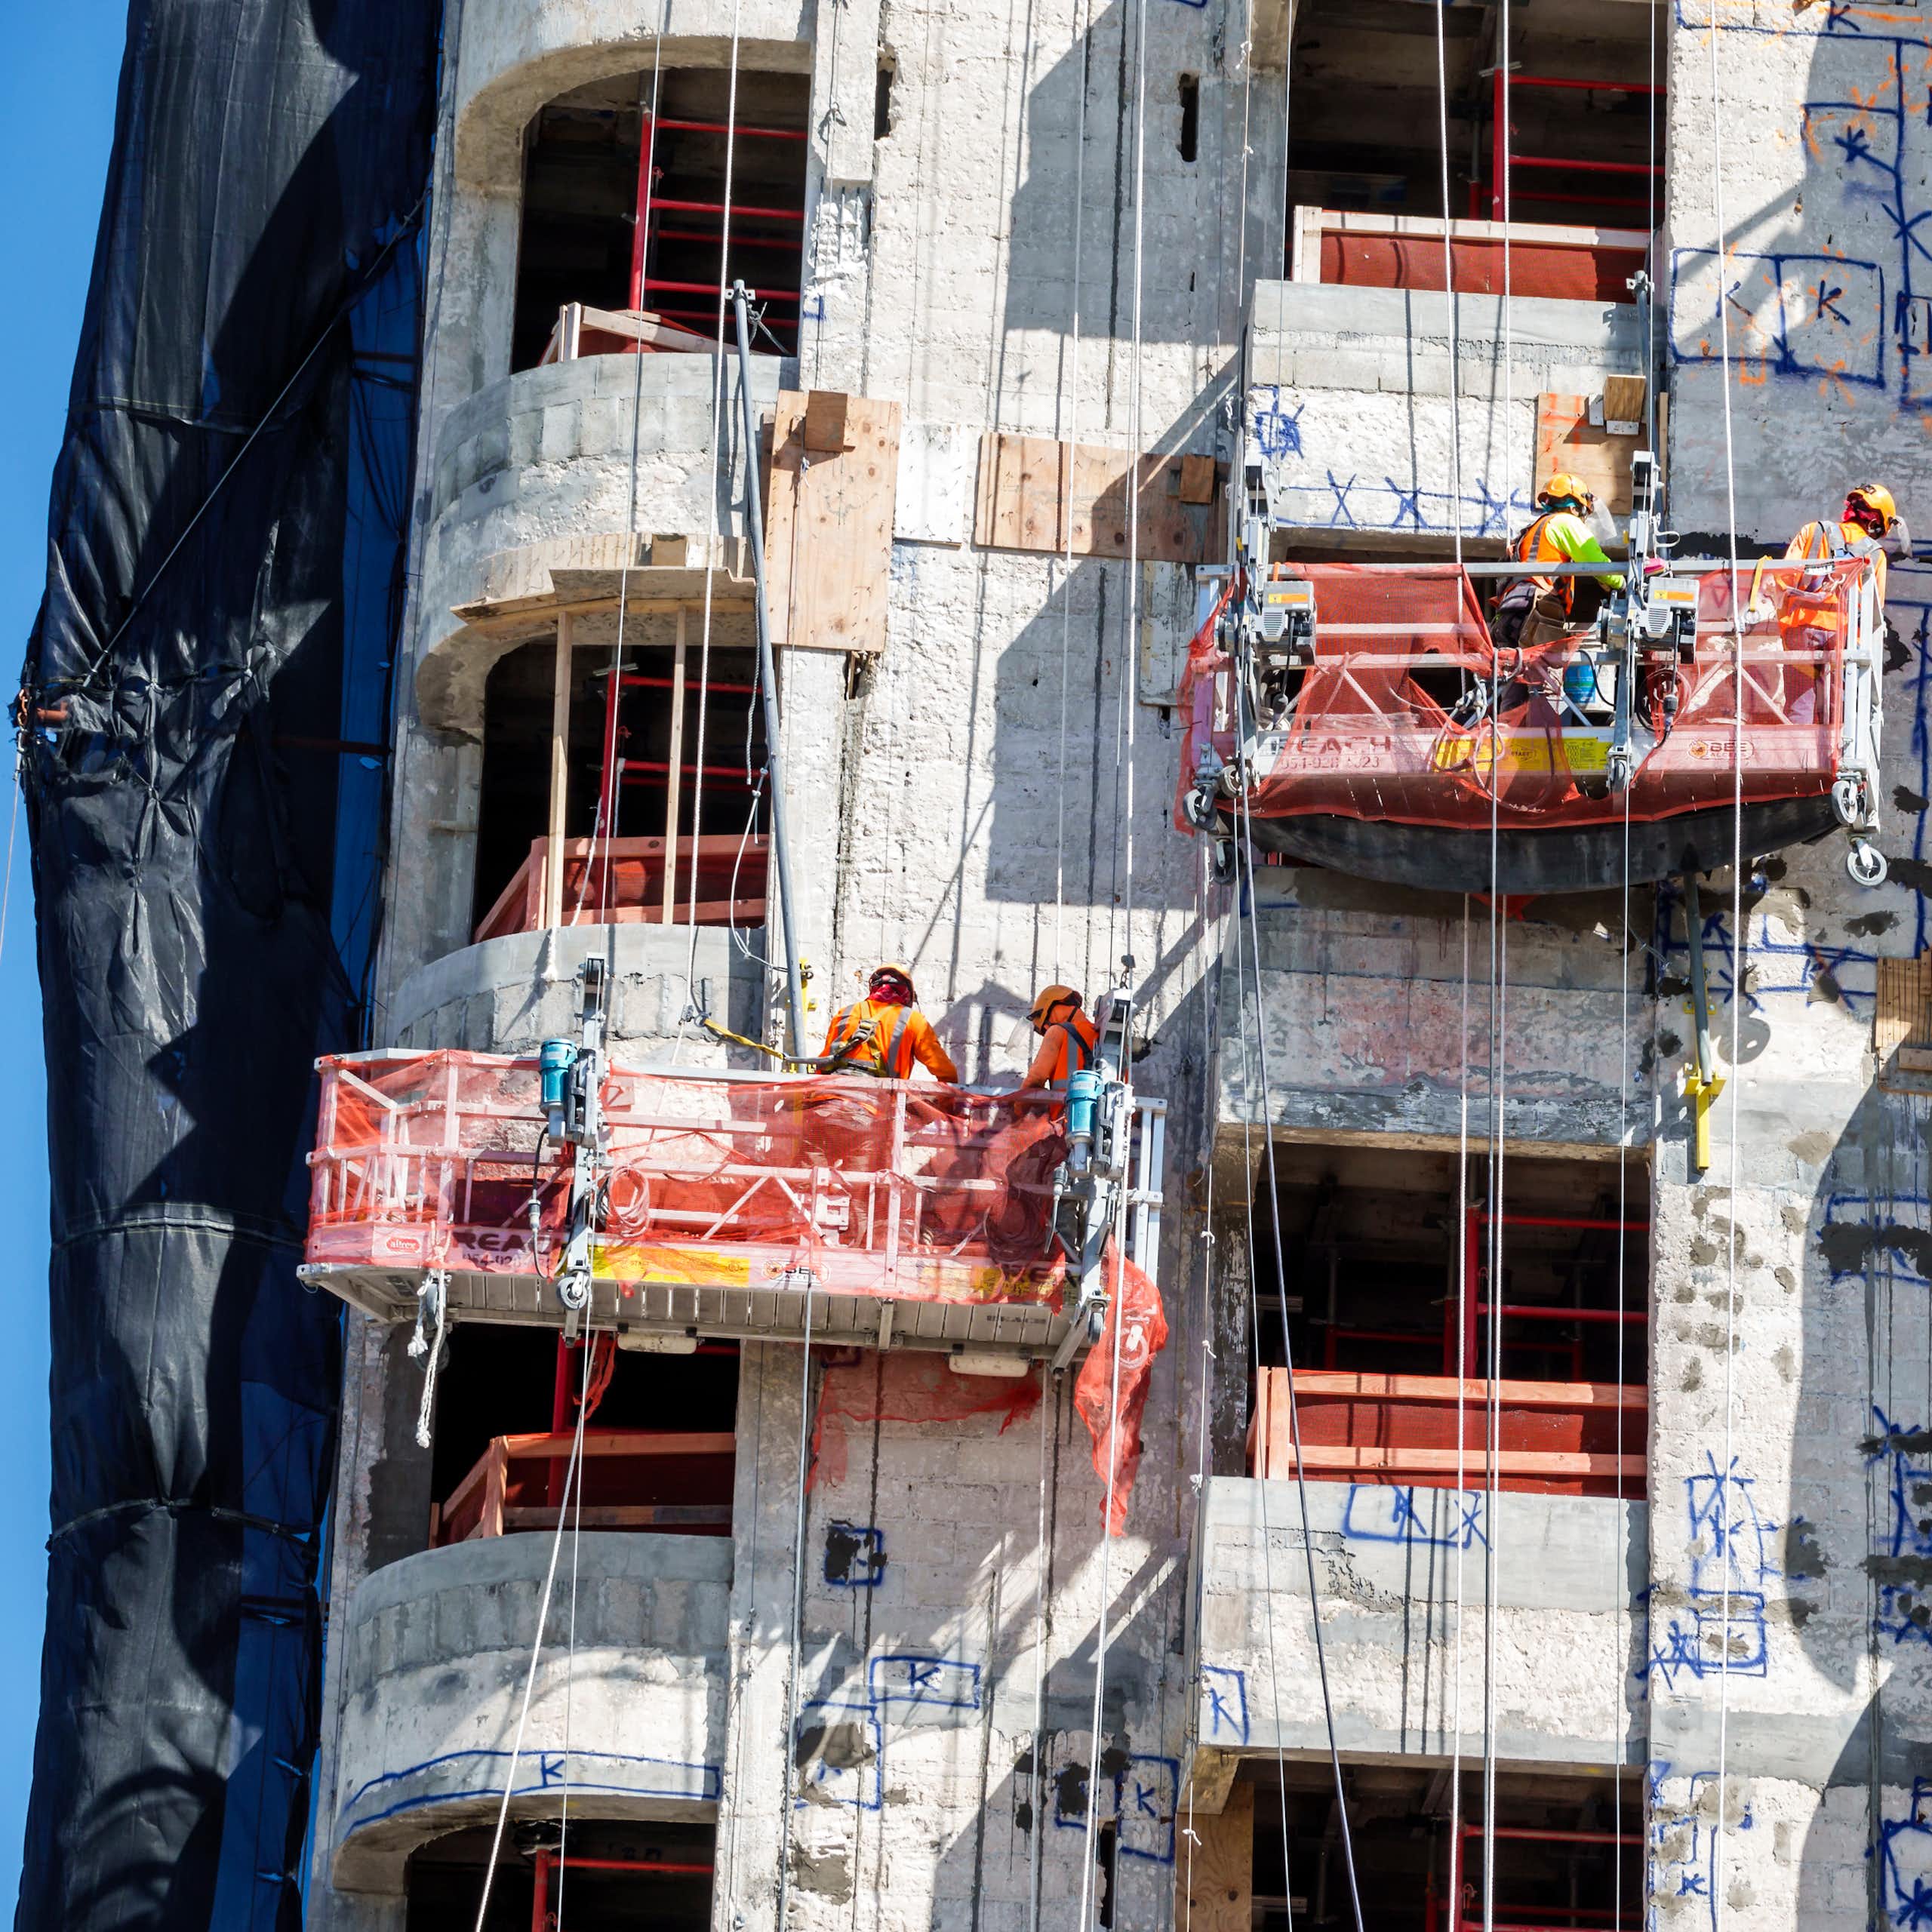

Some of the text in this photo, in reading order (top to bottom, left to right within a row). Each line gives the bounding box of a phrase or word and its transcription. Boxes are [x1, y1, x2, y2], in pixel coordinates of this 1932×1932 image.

[1817, 280, 1851, 325] K
[909, 1662, 941, 1694] K
[1210, 1687, 1244, 1739] K
[541, 1755, 565, 1788] K
[1137, 1782, 1156, 1817] K
